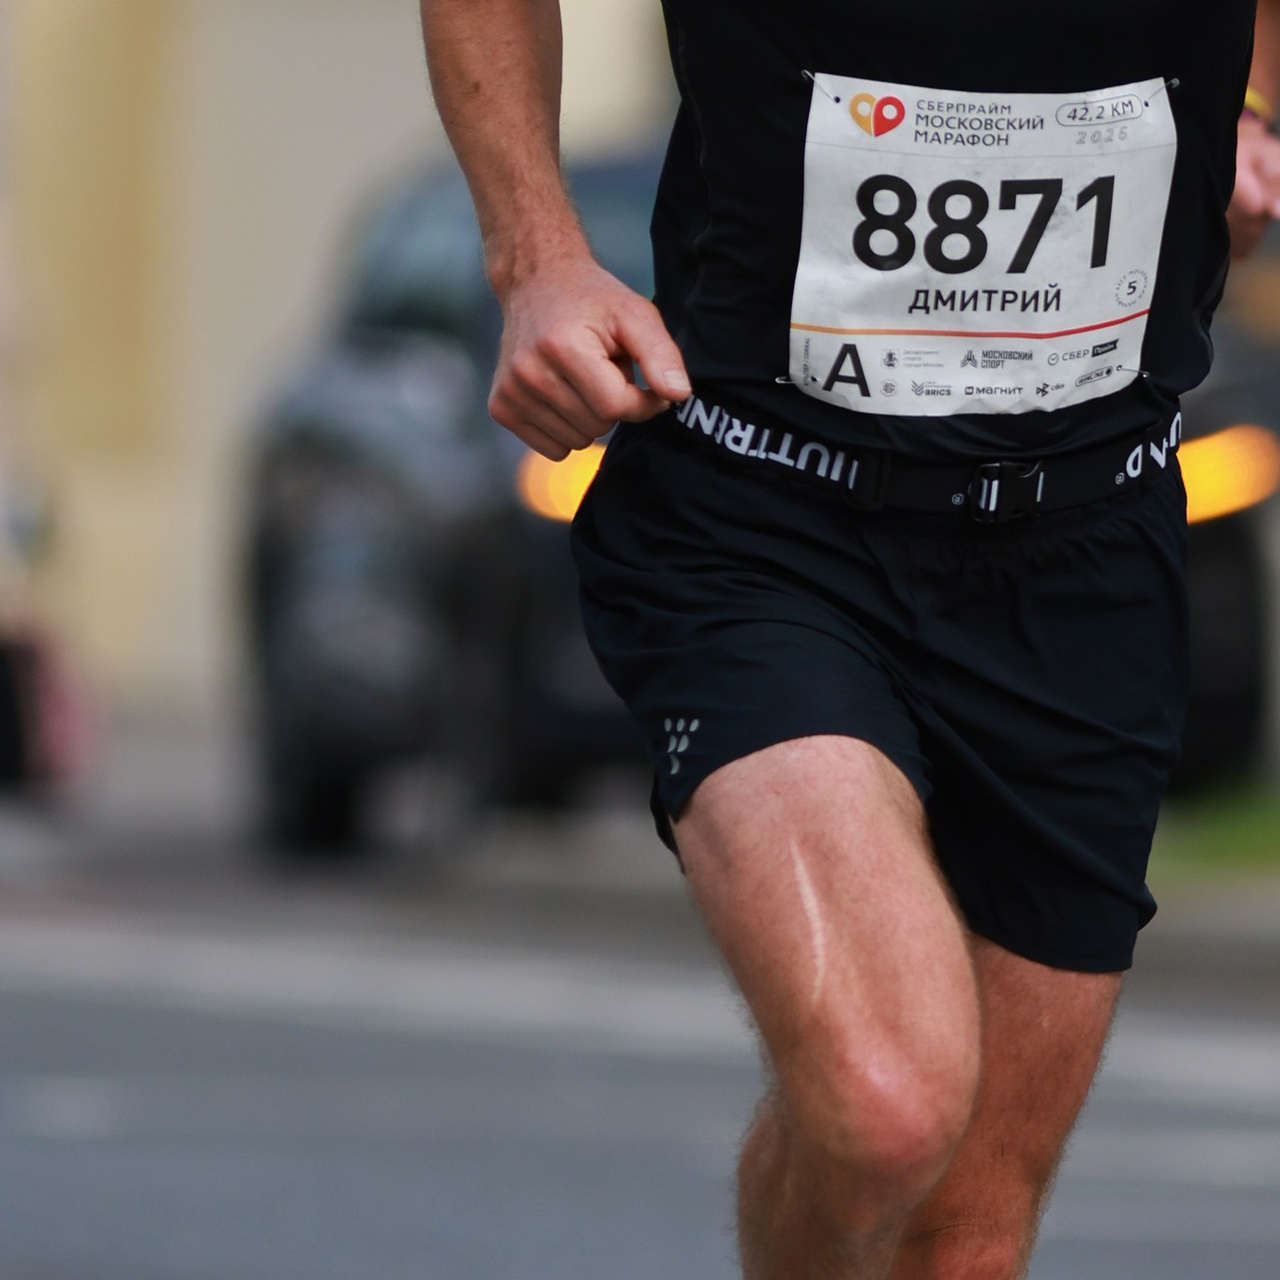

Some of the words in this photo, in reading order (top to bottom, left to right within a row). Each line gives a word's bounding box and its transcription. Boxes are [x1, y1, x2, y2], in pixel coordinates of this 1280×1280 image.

[916, 99, 1012, 114] СБЕРПРАЙМ
[1067, 106, 1105, 122] 42,2
[1111, 100, 1134, 117] КМ
[915, 113, 1044, 131] МОСКОВСКИЙ
[914, 130, 1010, 146] МАРАФОН
[852, 174, 1115, 274] 8871
[1127, 280, 1137, 296] 5
[908, 283, 1061, 315] ДМИТРИЙ
[981, 349, 1033, 361] МОСКОВСКИЙ
[1061, 349, 1090, 362] СБЕР
[822, 343, 871, 397] A
[980, 360, 1005, 369] СПОРТ
[925, 389, 951, 397] BRICS
